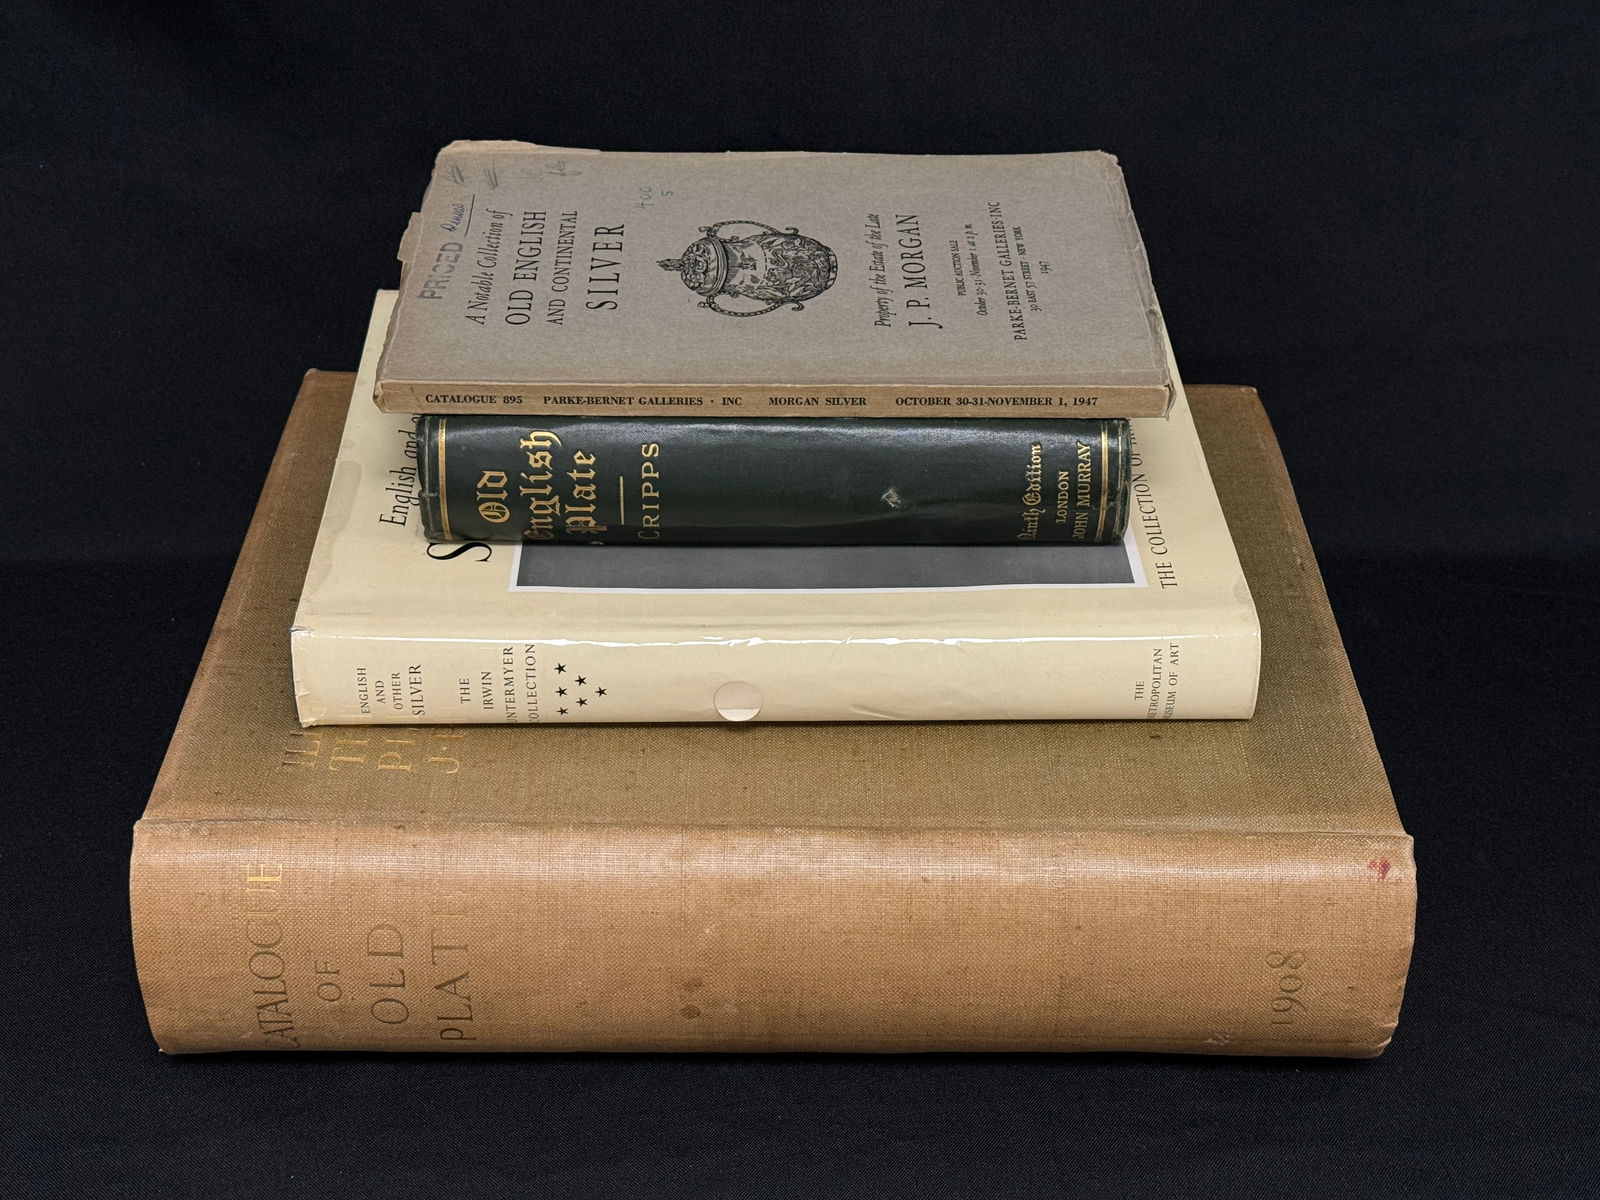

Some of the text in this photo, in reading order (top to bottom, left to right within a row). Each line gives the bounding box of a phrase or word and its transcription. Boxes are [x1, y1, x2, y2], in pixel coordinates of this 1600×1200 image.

[465, 208, 513, 325] A Notable Collection of
[513, 211, 547, 281] ENGLISH
[547, 211, 578, 326] AND CONTINENTAL
[586, 224, 625, 311] SILVER
[865, 213, 897, 327] Property of the Estate of the Late
[896, 214, 943, 329] J. P. MORGAN
[505, 290, 534, 325] OLD
[956, 278, 967, 296] PUBLIC
[974, 297, 989, 316] October
[1002, 269, 1028, 341] PARKE-BERNET
[425, 393, 523, 405] CATALOGUE 895
[543, 395, 743, 407] PARKE-BERNET GALLERIES INC
[768, 396, 867, 407] MORGAN SILVER
[895, 395, 1099, 409] OCTOBER 30-31-NOVEMBER 1, 1947
[379, 429, 420, 527] English and
[476, 470, 511, 524] Old
[519, 430, 562, 540] English
[564, 450, 608, 534] Plate
[637, 442, 661, 541] CRIPPS
[1022, 442, 1042, 506] Edition
[1055, 470, 1070, 525] LONDON
[1072, 440, 1092, 540] JOHN MURRAY
[1131, 473, 1168, 555] COLLECTION
[1155, 561, 1178, 589] THE
[1168, 671, 1179, 687] OF
[1169, 642, 1179, 666] ART
[356, 667, 371, 715] ENGLISH
[374, 679, 386, 704] AND
[391, 671, 404, 711] OTHER
[408, 663, 426, 717] SILVER
[459, 677, 472, 705] THE
[480, 671, 495, 711] IRWIN
[1135, 681, 1145, 700] THE
[315, 960, 342, 1002] OF
[367, 923, 409, 1025] OLD
[1266, 951, 1306, 1024] 1908
